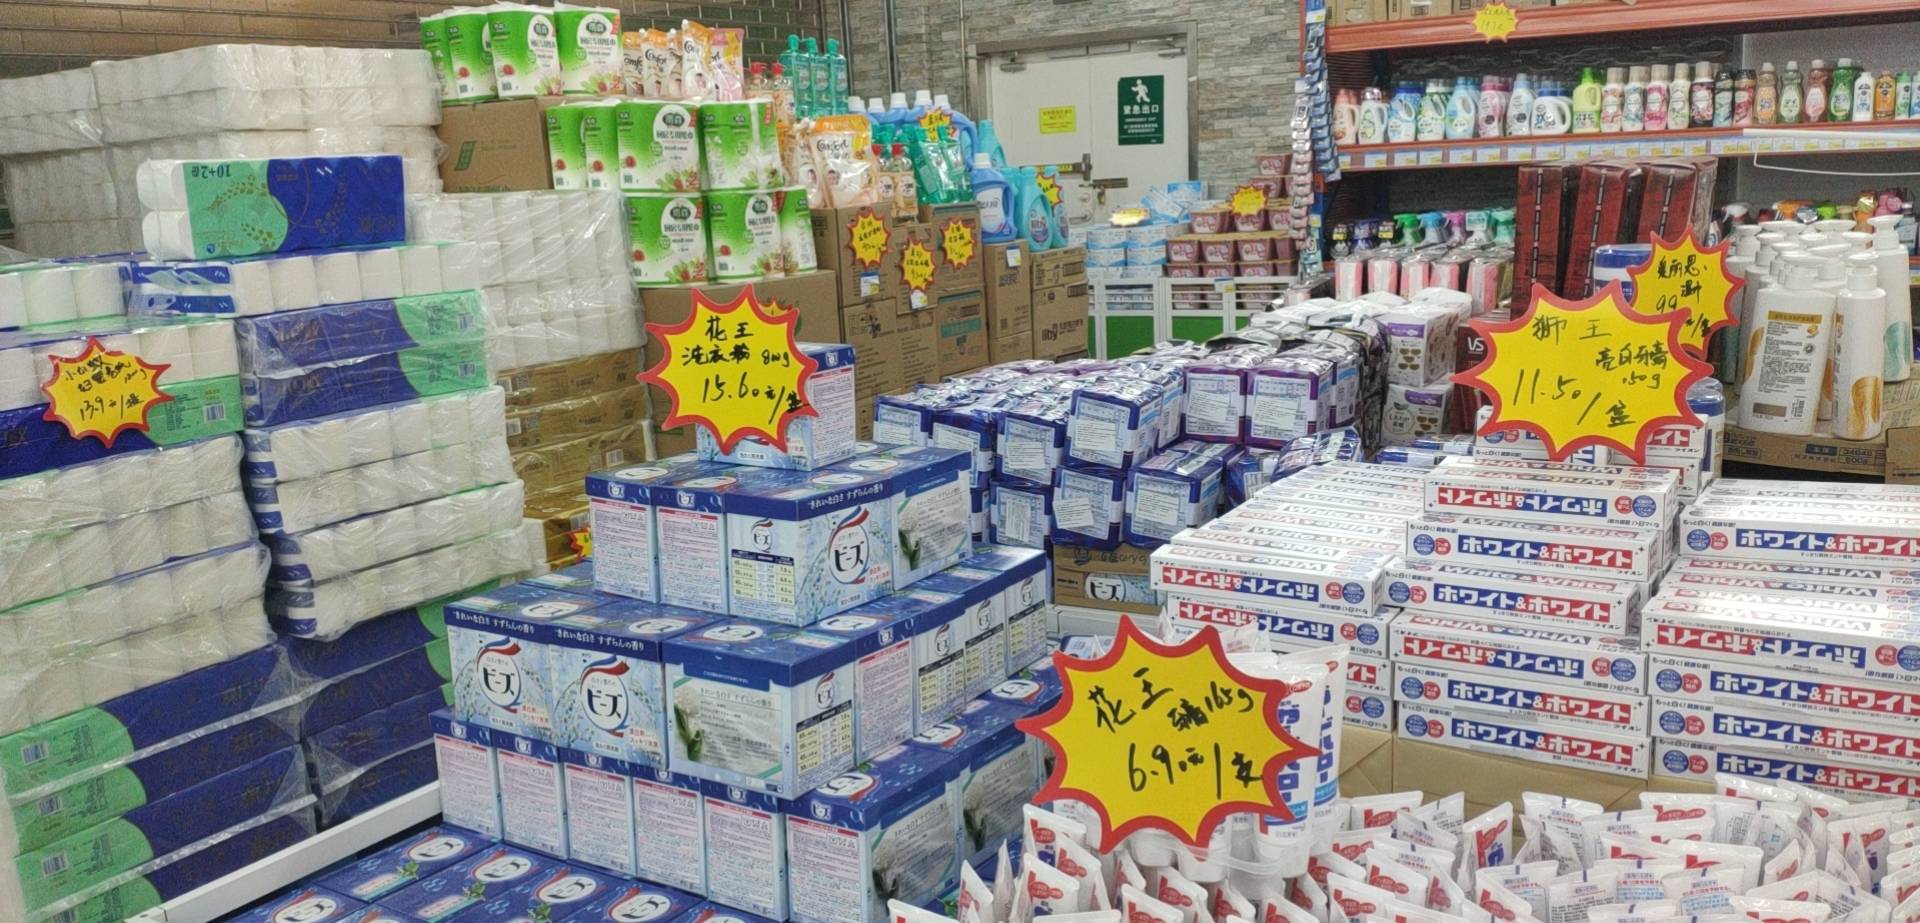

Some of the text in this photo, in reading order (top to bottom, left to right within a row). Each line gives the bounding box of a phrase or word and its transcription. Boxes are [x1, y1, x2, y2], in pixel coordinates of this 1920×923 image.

[705, 316, 754, 342] 花王
[1468, 337, 1484, 351] VS
[1532, 315, 1612, 344] 狮王
[1596, 340, 1668, 371] 亮白牙膏
[1440, 488, 1604, 516] ホワイト&ホワイト
[1462, 536, 1632, 568] ホワイト&ホワイト
[1164, 568, 1316, 600] ホワイト&ホワイト
[1438, 584, 1611, 619] ホワイト&ホワイト
[1405, 640, 1583, 676] ホワイト&ホワイト
[1088, 667, 1174, 734] 花王
[1453, 682, 1631, 722] ホワイト&ホワイト
[1456, 720, 1632, 764] ホワイト&ホワイト
